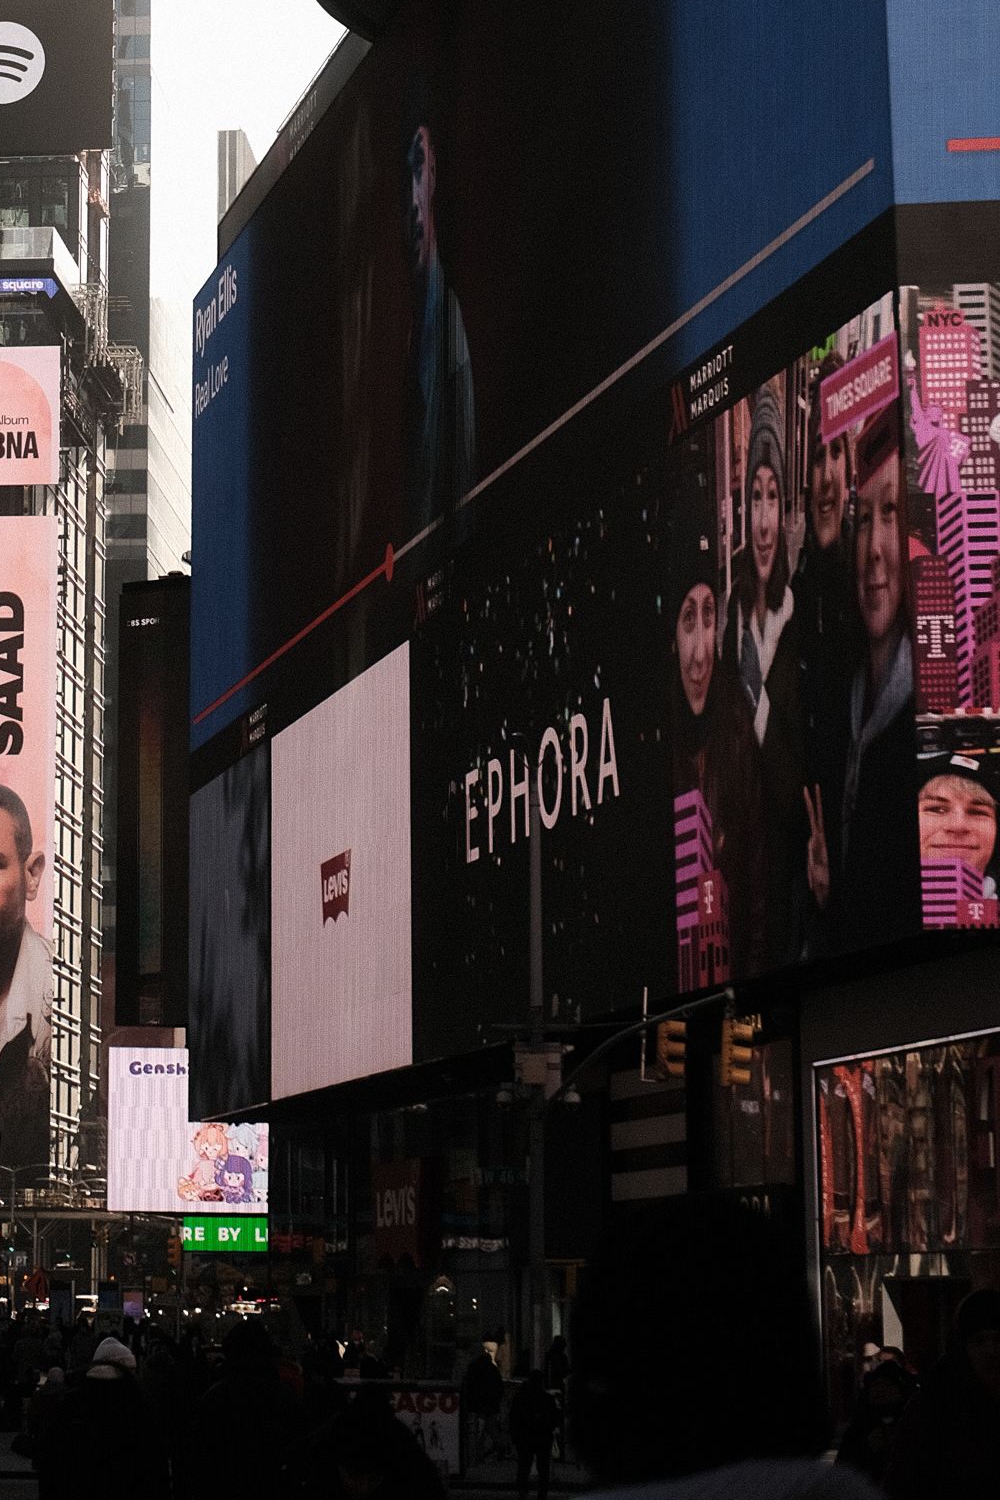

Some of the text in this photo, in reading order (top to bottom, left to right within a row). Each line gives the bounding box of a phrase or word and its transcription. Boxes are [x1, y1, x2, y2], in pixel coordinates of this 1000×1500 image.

[3, 280, 44, 291] square
[195, 264, 238, 358] Ryan Ellis
[927, 313, 962, 327] NYC
[195, 355, 229, 419] Real Love
[689, 345, 734, 393] MARRIOTT
[826, 356, 892, 421] TIMES SQUARE
[690, 377, 730, 420] MARQUIS
[129, 1061, 189, 1076] Gensh
[218, 1227, 241, 1242] BY
